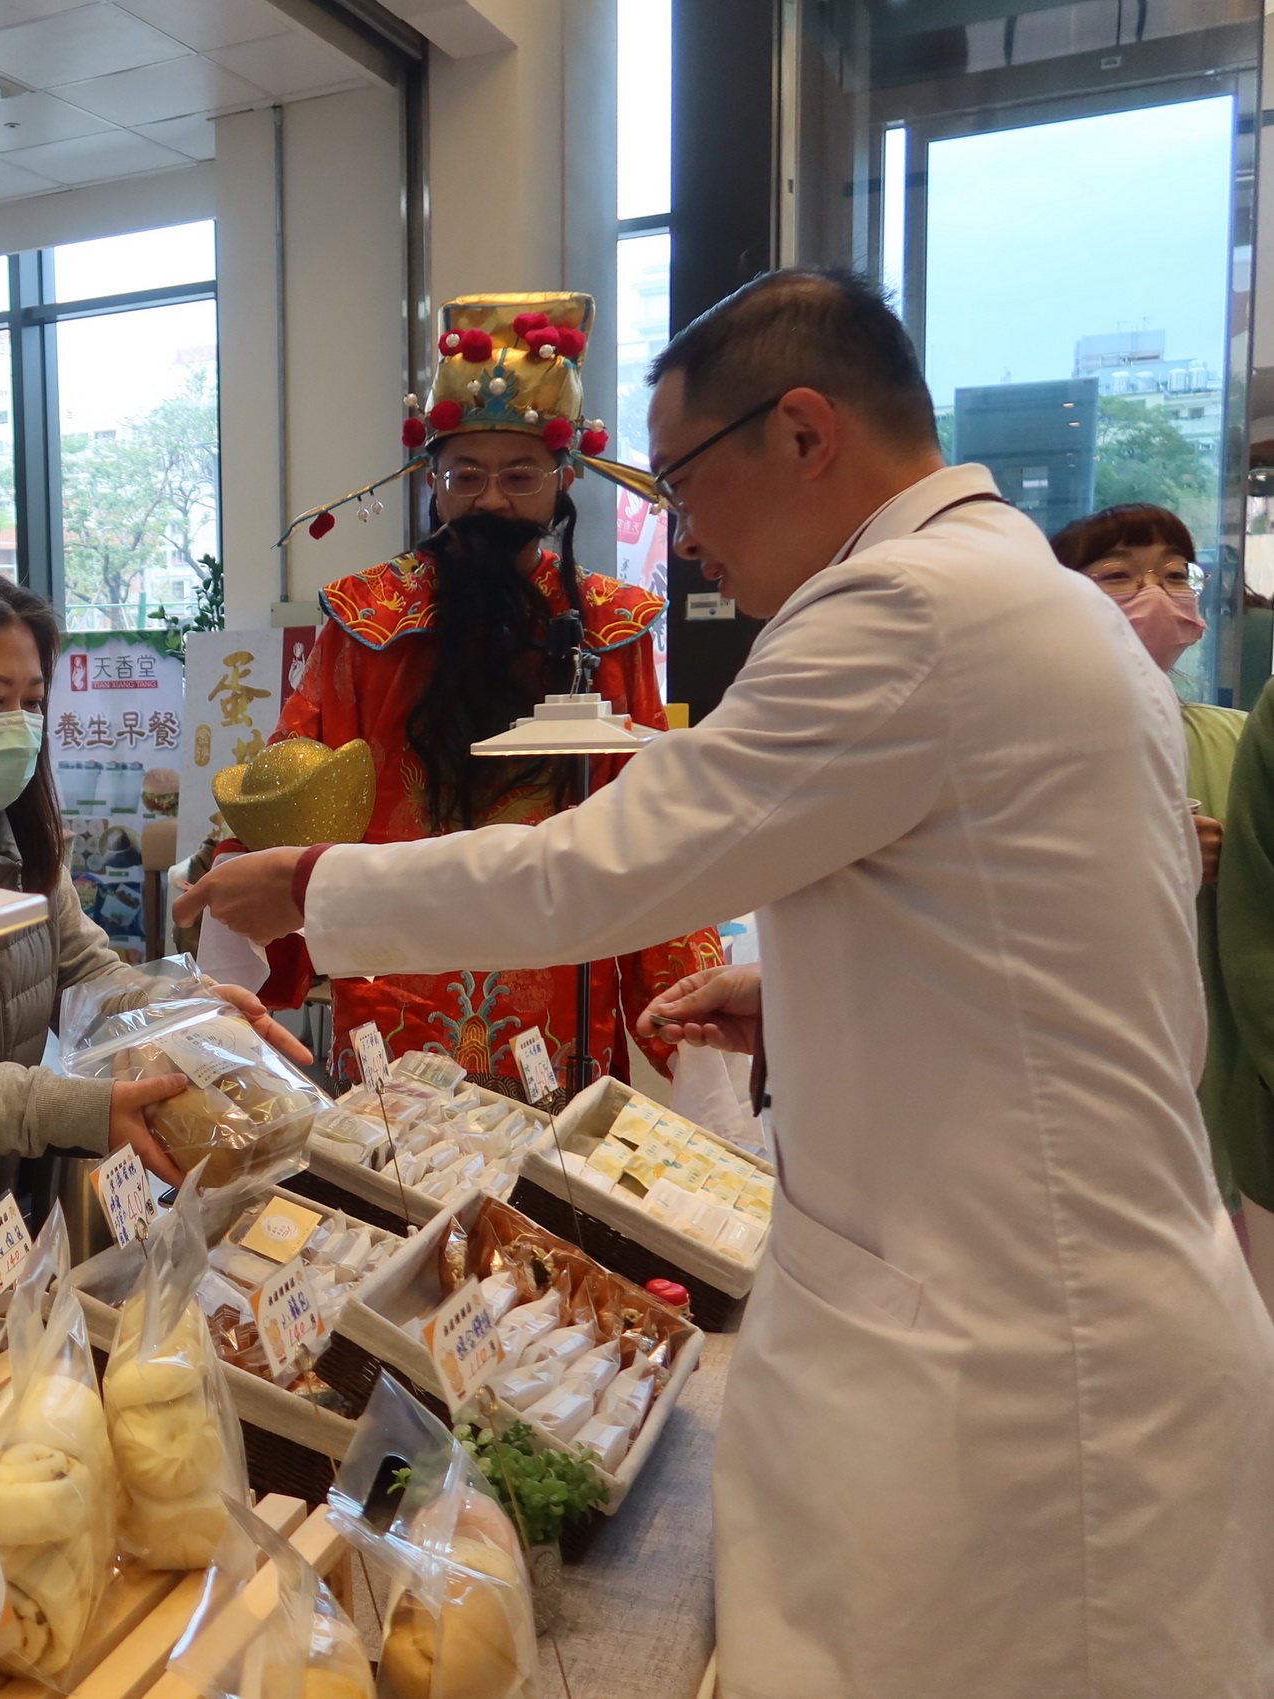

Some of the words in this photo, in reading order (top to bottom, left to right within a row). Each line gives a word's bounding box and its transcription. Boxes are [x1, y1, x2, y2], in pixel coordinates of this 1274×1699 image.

[92, 654, 156, 679] 天香堂
[93, 681, 110, 689] TIAN
[112, 681, 134, 689] XIANG
[136, 680, 156, 688] TANG
[55, 711, 178, 747] 養生早餐
